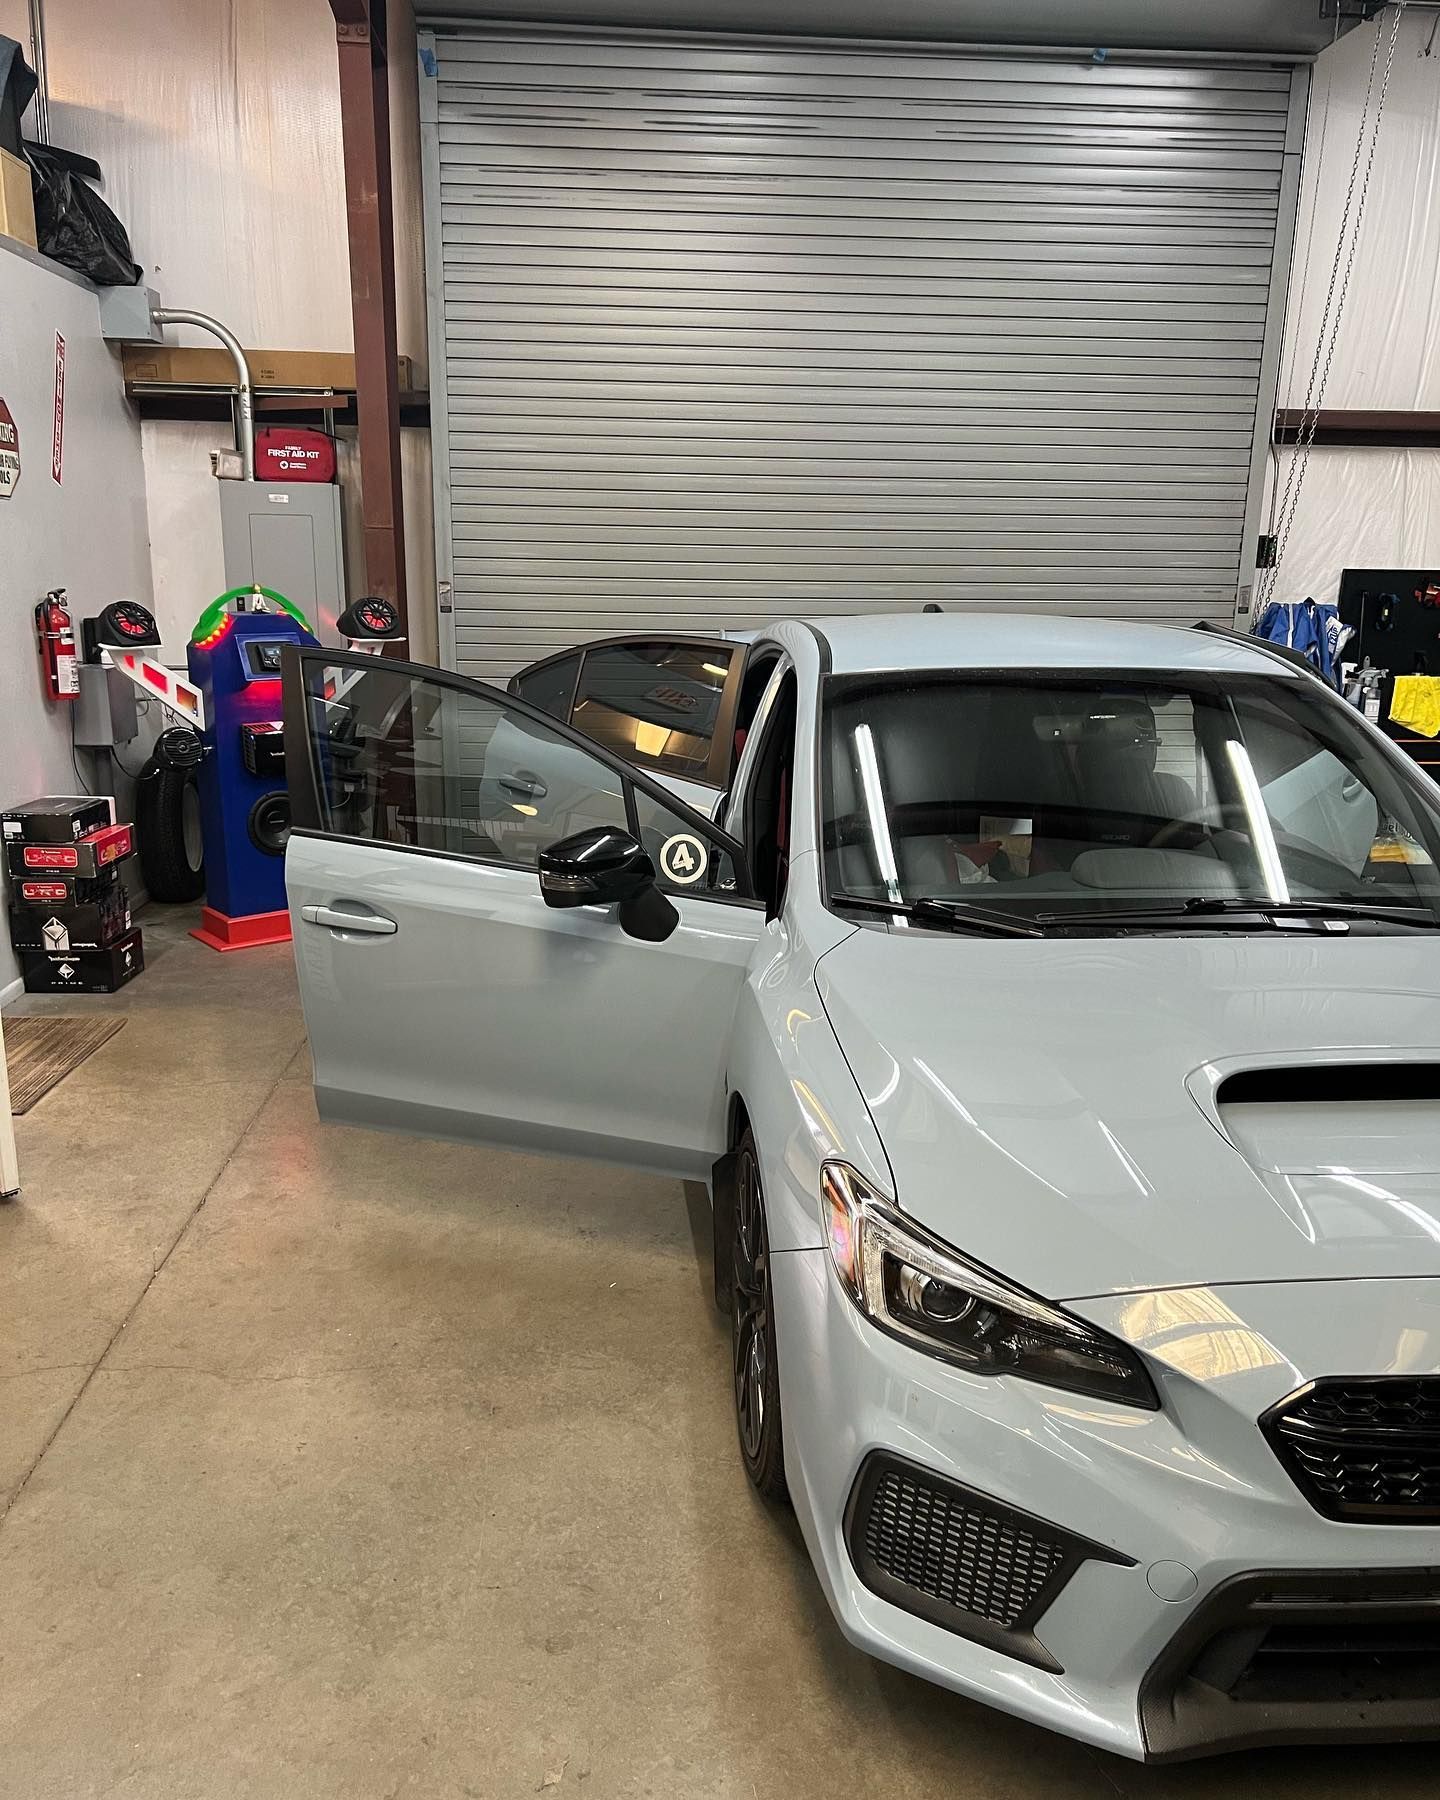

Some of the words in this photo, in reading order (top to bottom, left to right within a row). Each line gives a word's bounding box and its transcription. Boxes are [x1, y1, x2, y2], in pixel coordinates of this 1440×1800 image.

[267, 448, 291, 458] FIRST
[291, 450, 306, 458] AID
[306, 451, 320, 459] KIT
[671, 843, 695, 871] 4
